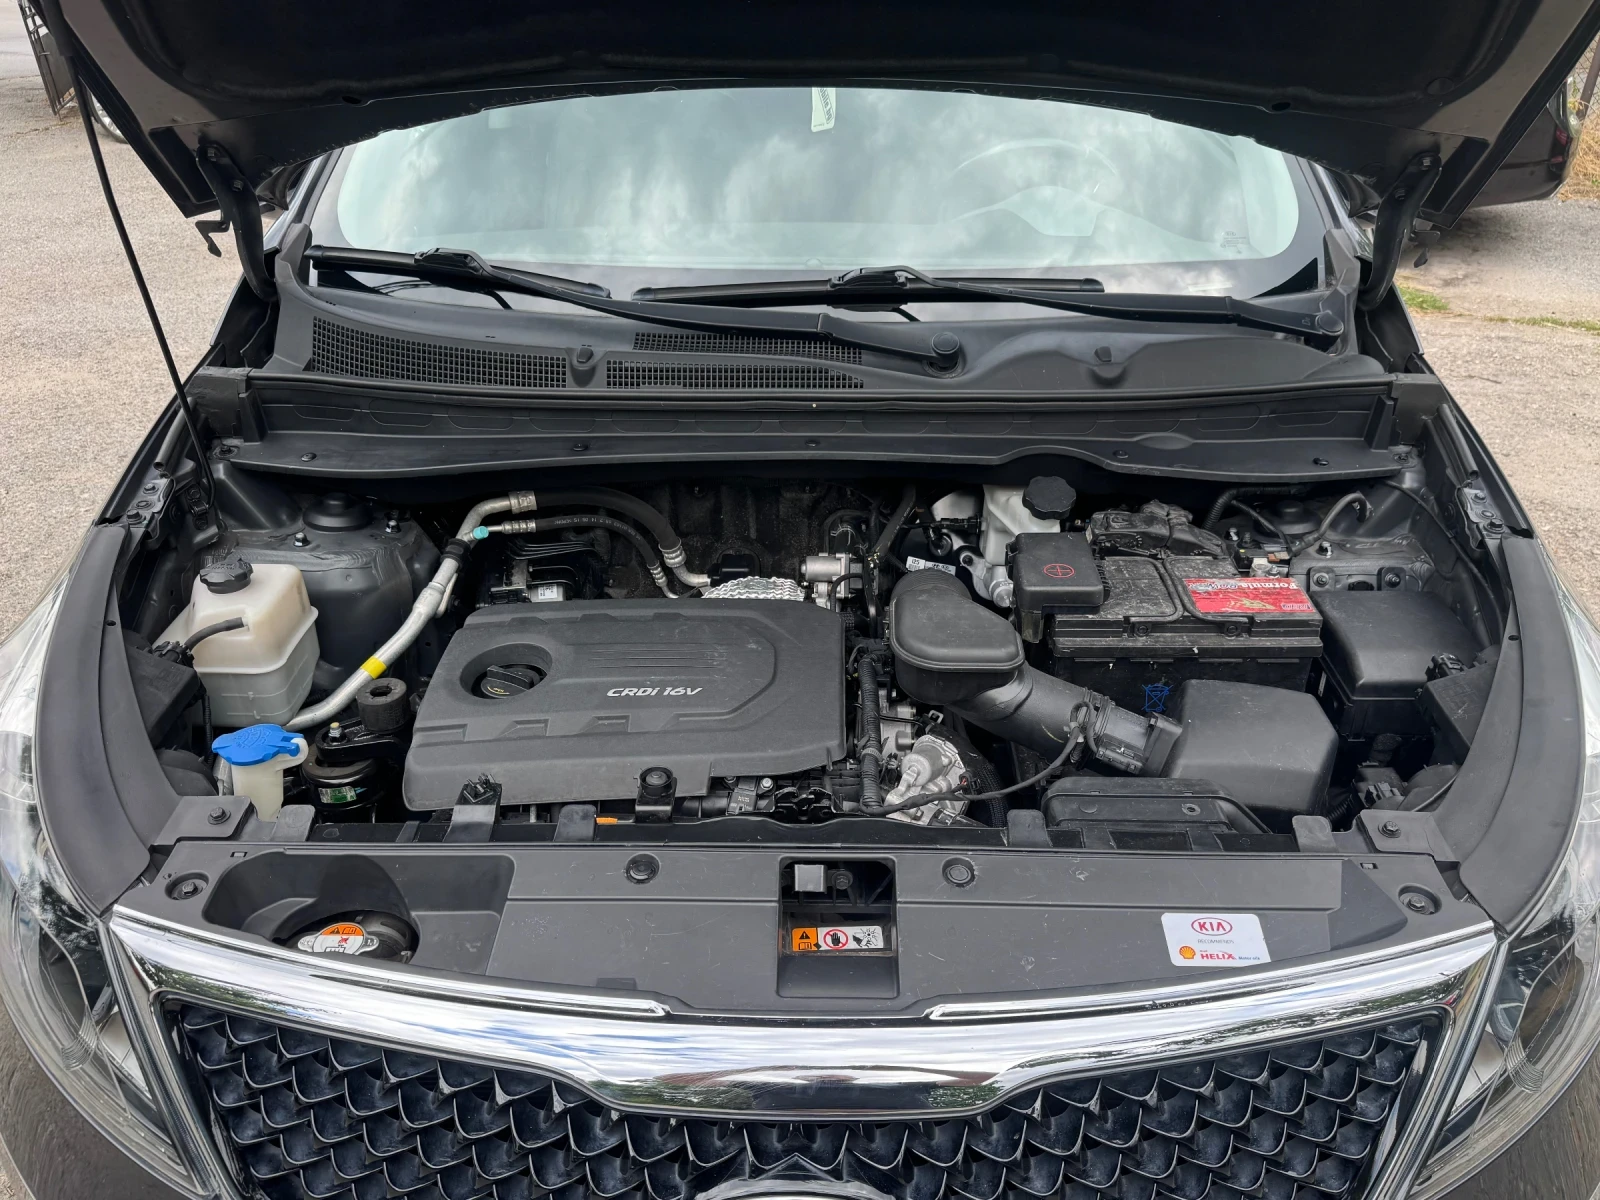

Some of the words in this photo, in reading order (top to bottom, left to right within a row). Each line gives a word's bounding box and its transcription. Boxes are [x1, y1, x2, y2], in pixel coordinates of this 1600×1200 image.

[819, 87, 833, 122] obile.bg
[1240, 582, 1299, 590] Formula
[662, 686, 703, 696] 16V
[1198, 922, 1226, 931] KIA
